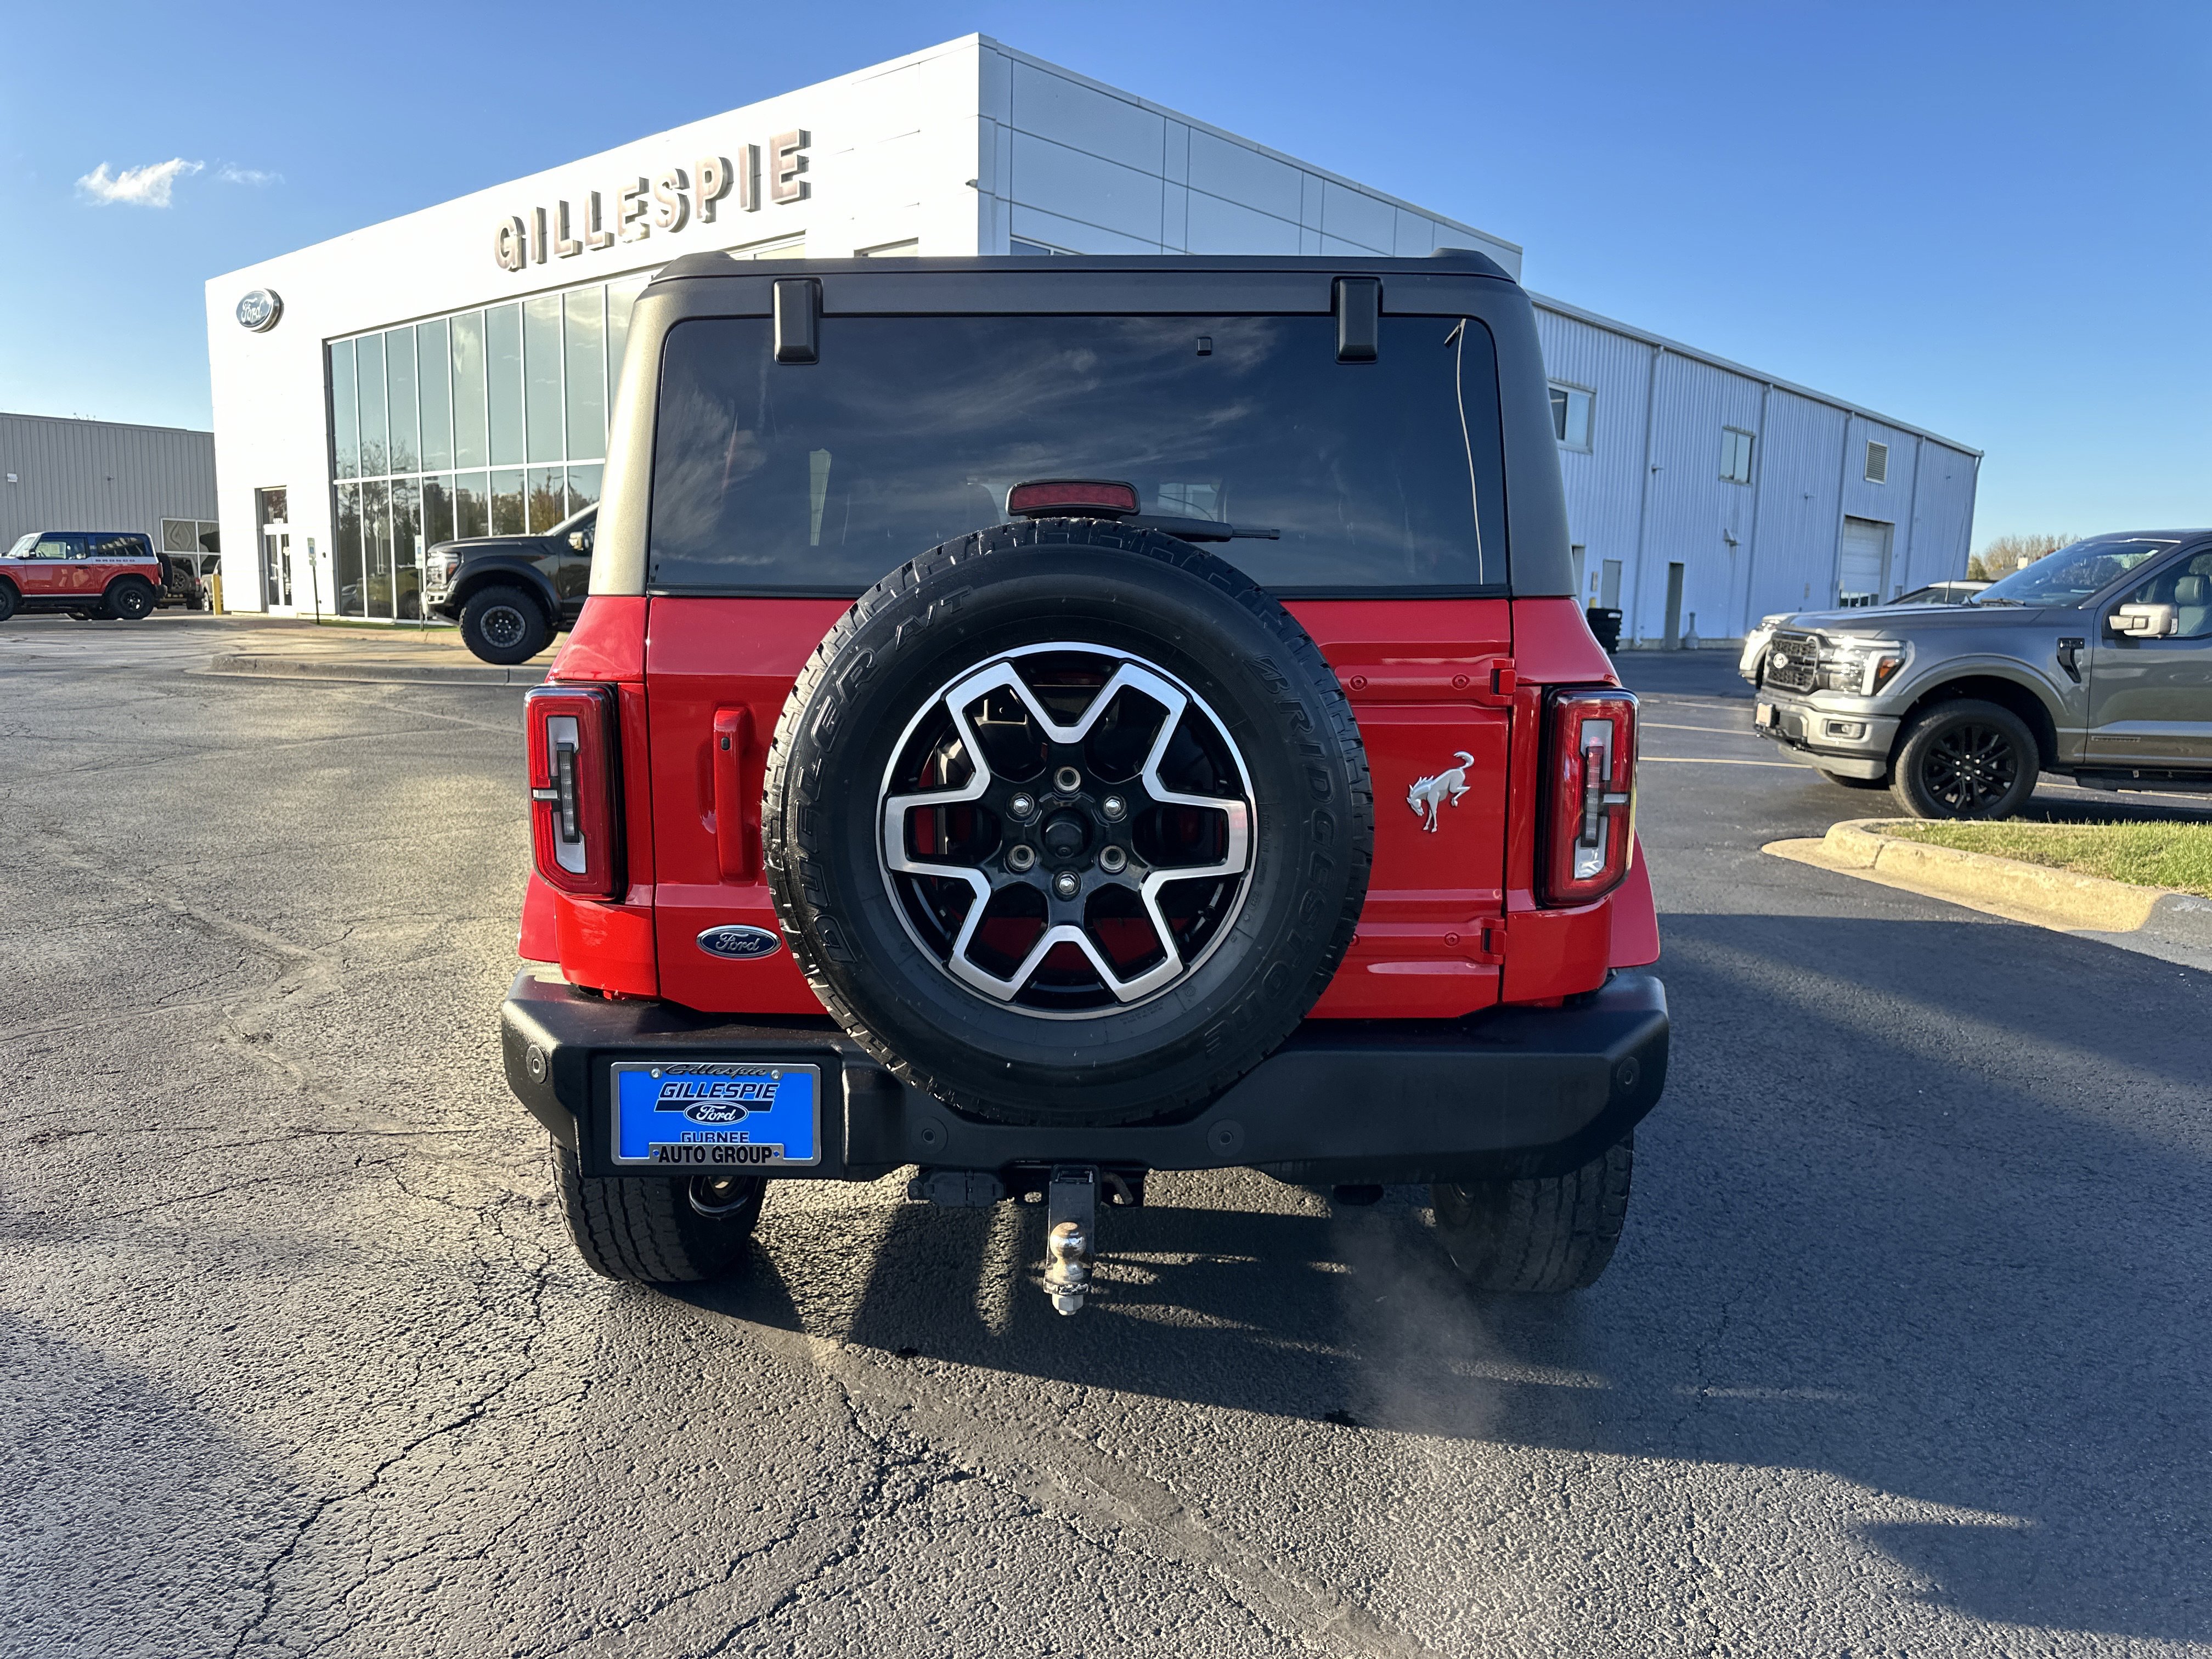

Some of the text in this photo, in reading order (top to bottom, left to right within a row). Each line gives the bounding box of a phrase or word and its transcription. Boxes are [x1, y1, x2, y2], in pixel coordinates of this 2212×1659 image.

[494, 128, 811, 273] GILLESPIE
[241, 297, 266, 323] Ford
[895, 587, 973, 651] A/T
[715, 933, 760, 951] Ford
[665, 1063, 768, 1080] Gillespie
[659, 1081, 780, 1100] GILLESPIE
[696, 1104, 736, 1121] Ford
[680, 1131, 750, 1143] GURNEE
[658, 1145, 772, 1164] AUTO GROUP
